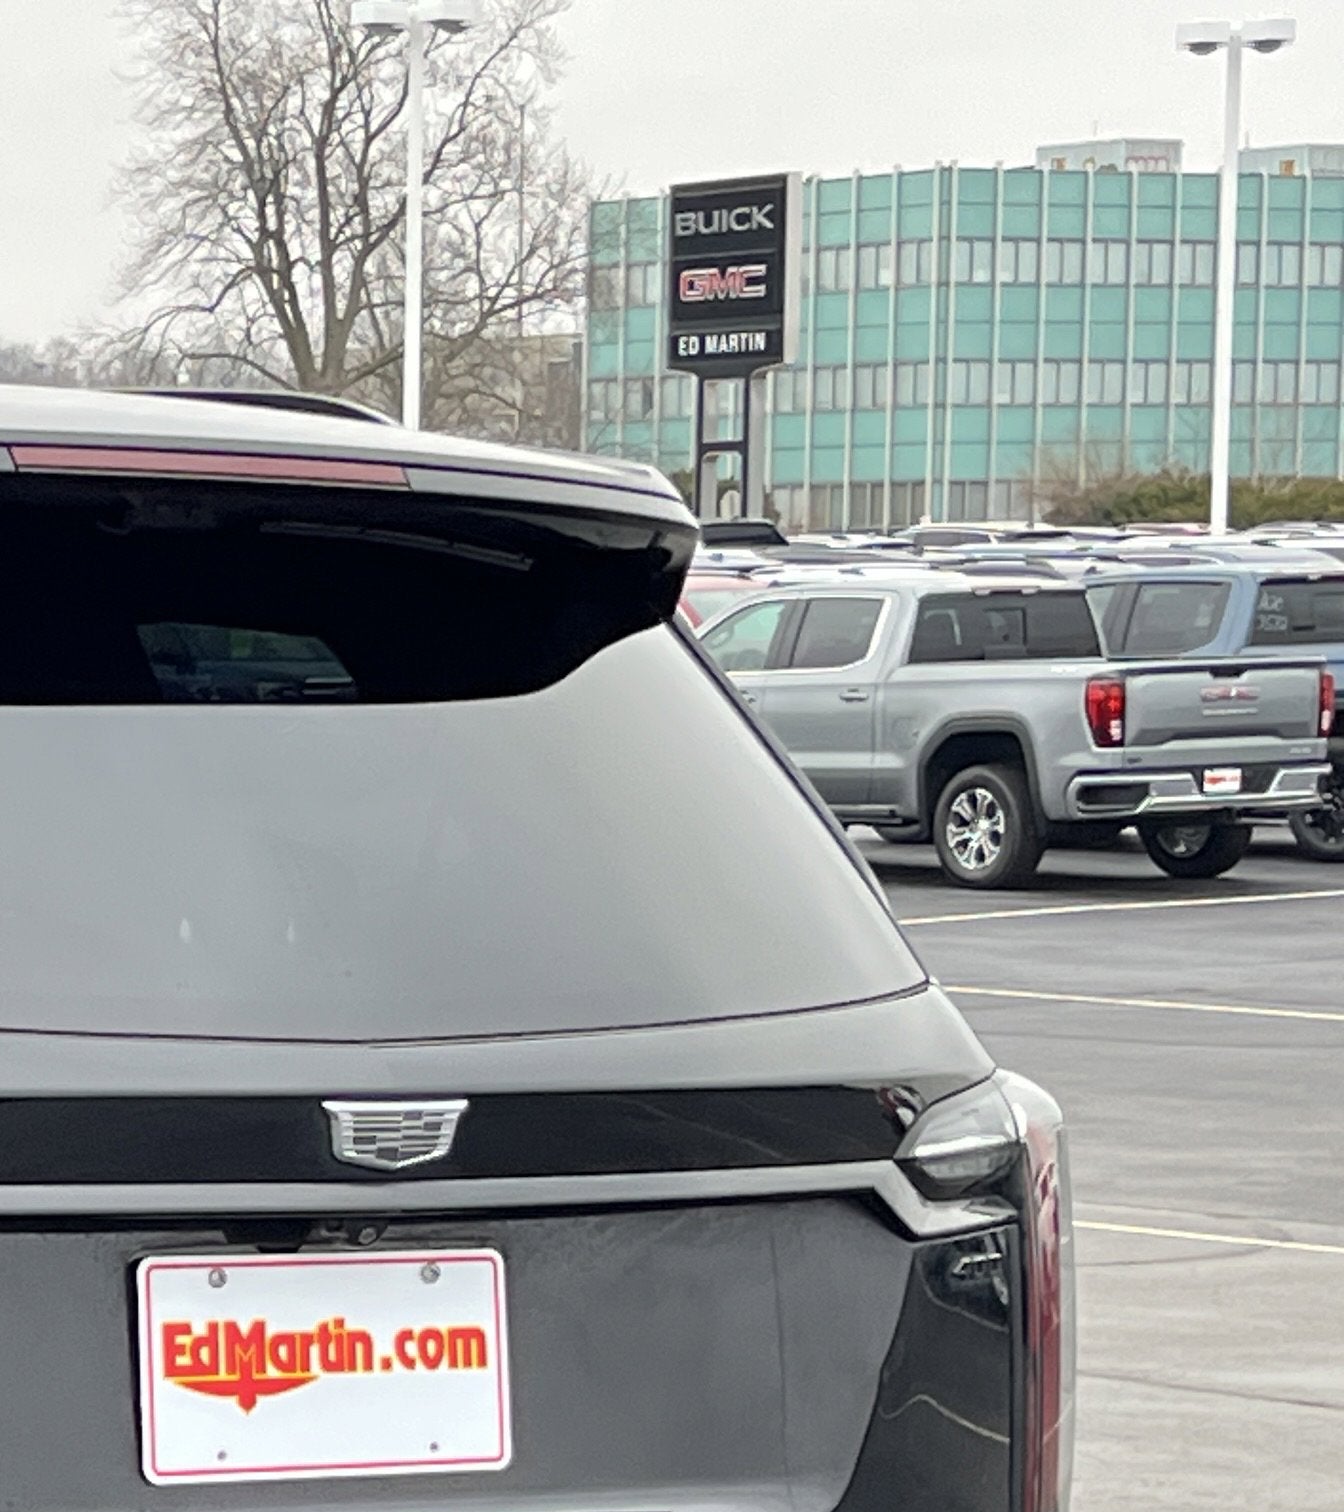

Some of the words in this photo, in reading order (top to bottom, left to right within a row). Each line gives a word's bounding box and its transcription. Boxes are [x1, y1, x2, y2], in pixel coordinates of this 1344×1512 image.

[674, 203, 775, 237] BUICK
[679, 263, 768, 302] GMC
[678, 335, 700, 356] ED
[704, 331, 766, 354] MARTIN
[161, 1316, 488, 1387] EdMartin.com
